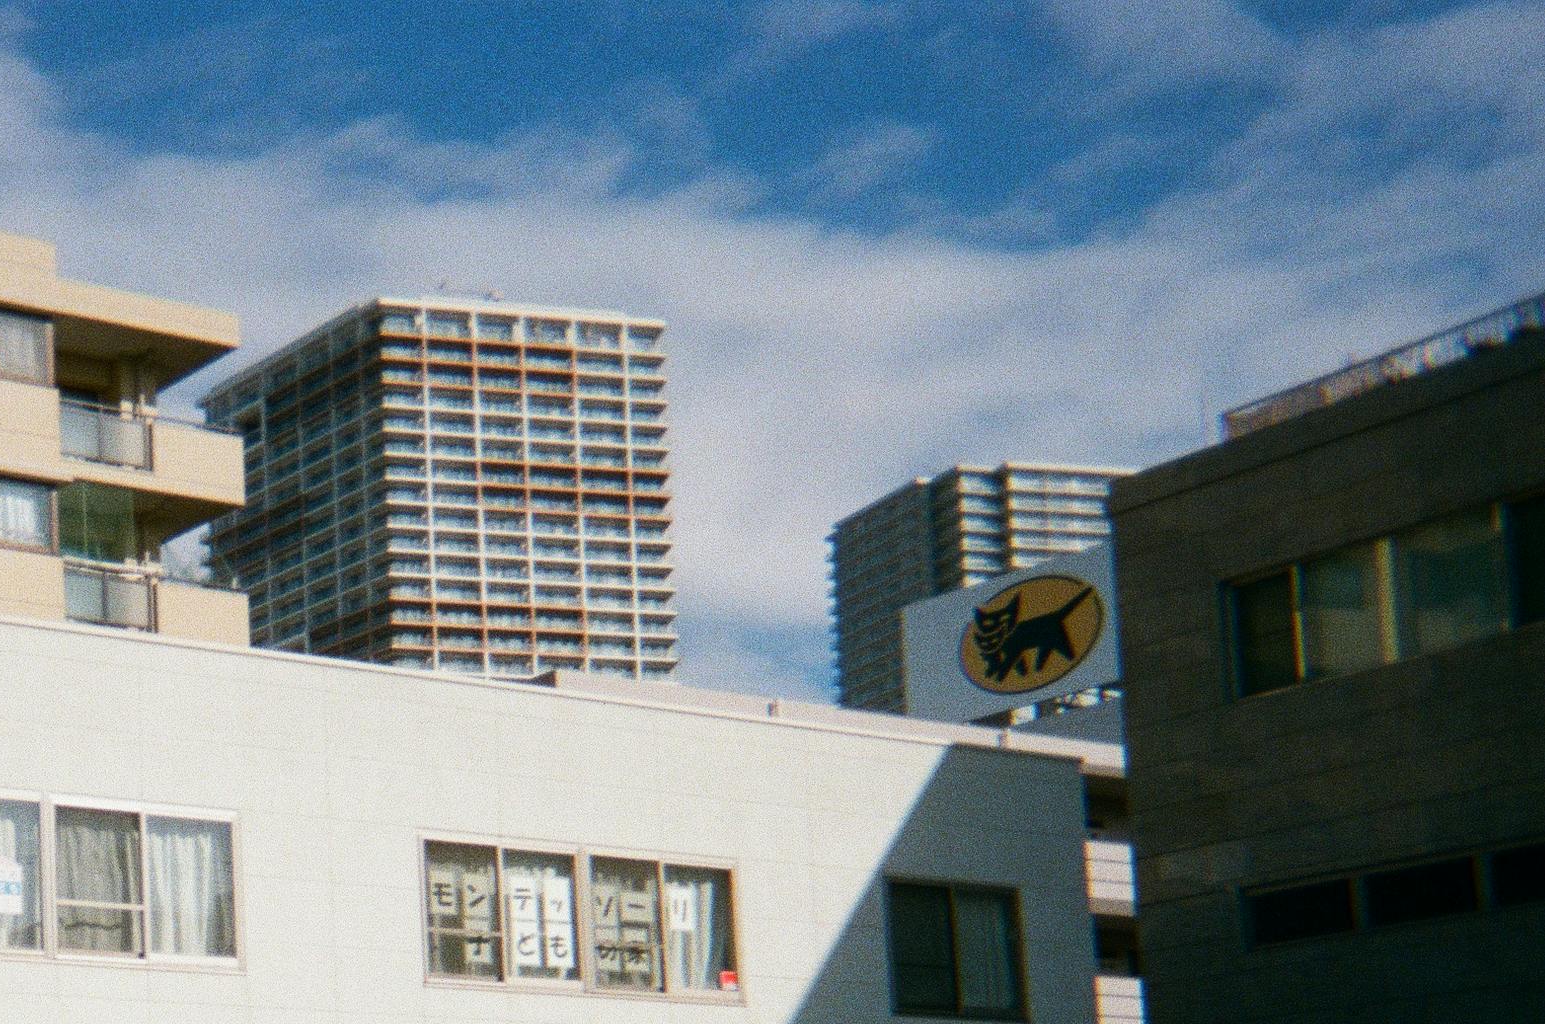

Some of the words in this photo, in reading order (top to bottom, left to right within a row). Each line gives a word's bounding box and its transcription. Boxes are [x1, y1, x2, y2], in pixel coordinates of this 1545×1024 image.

[433, 881, 687, 919] モンテッソーリ
